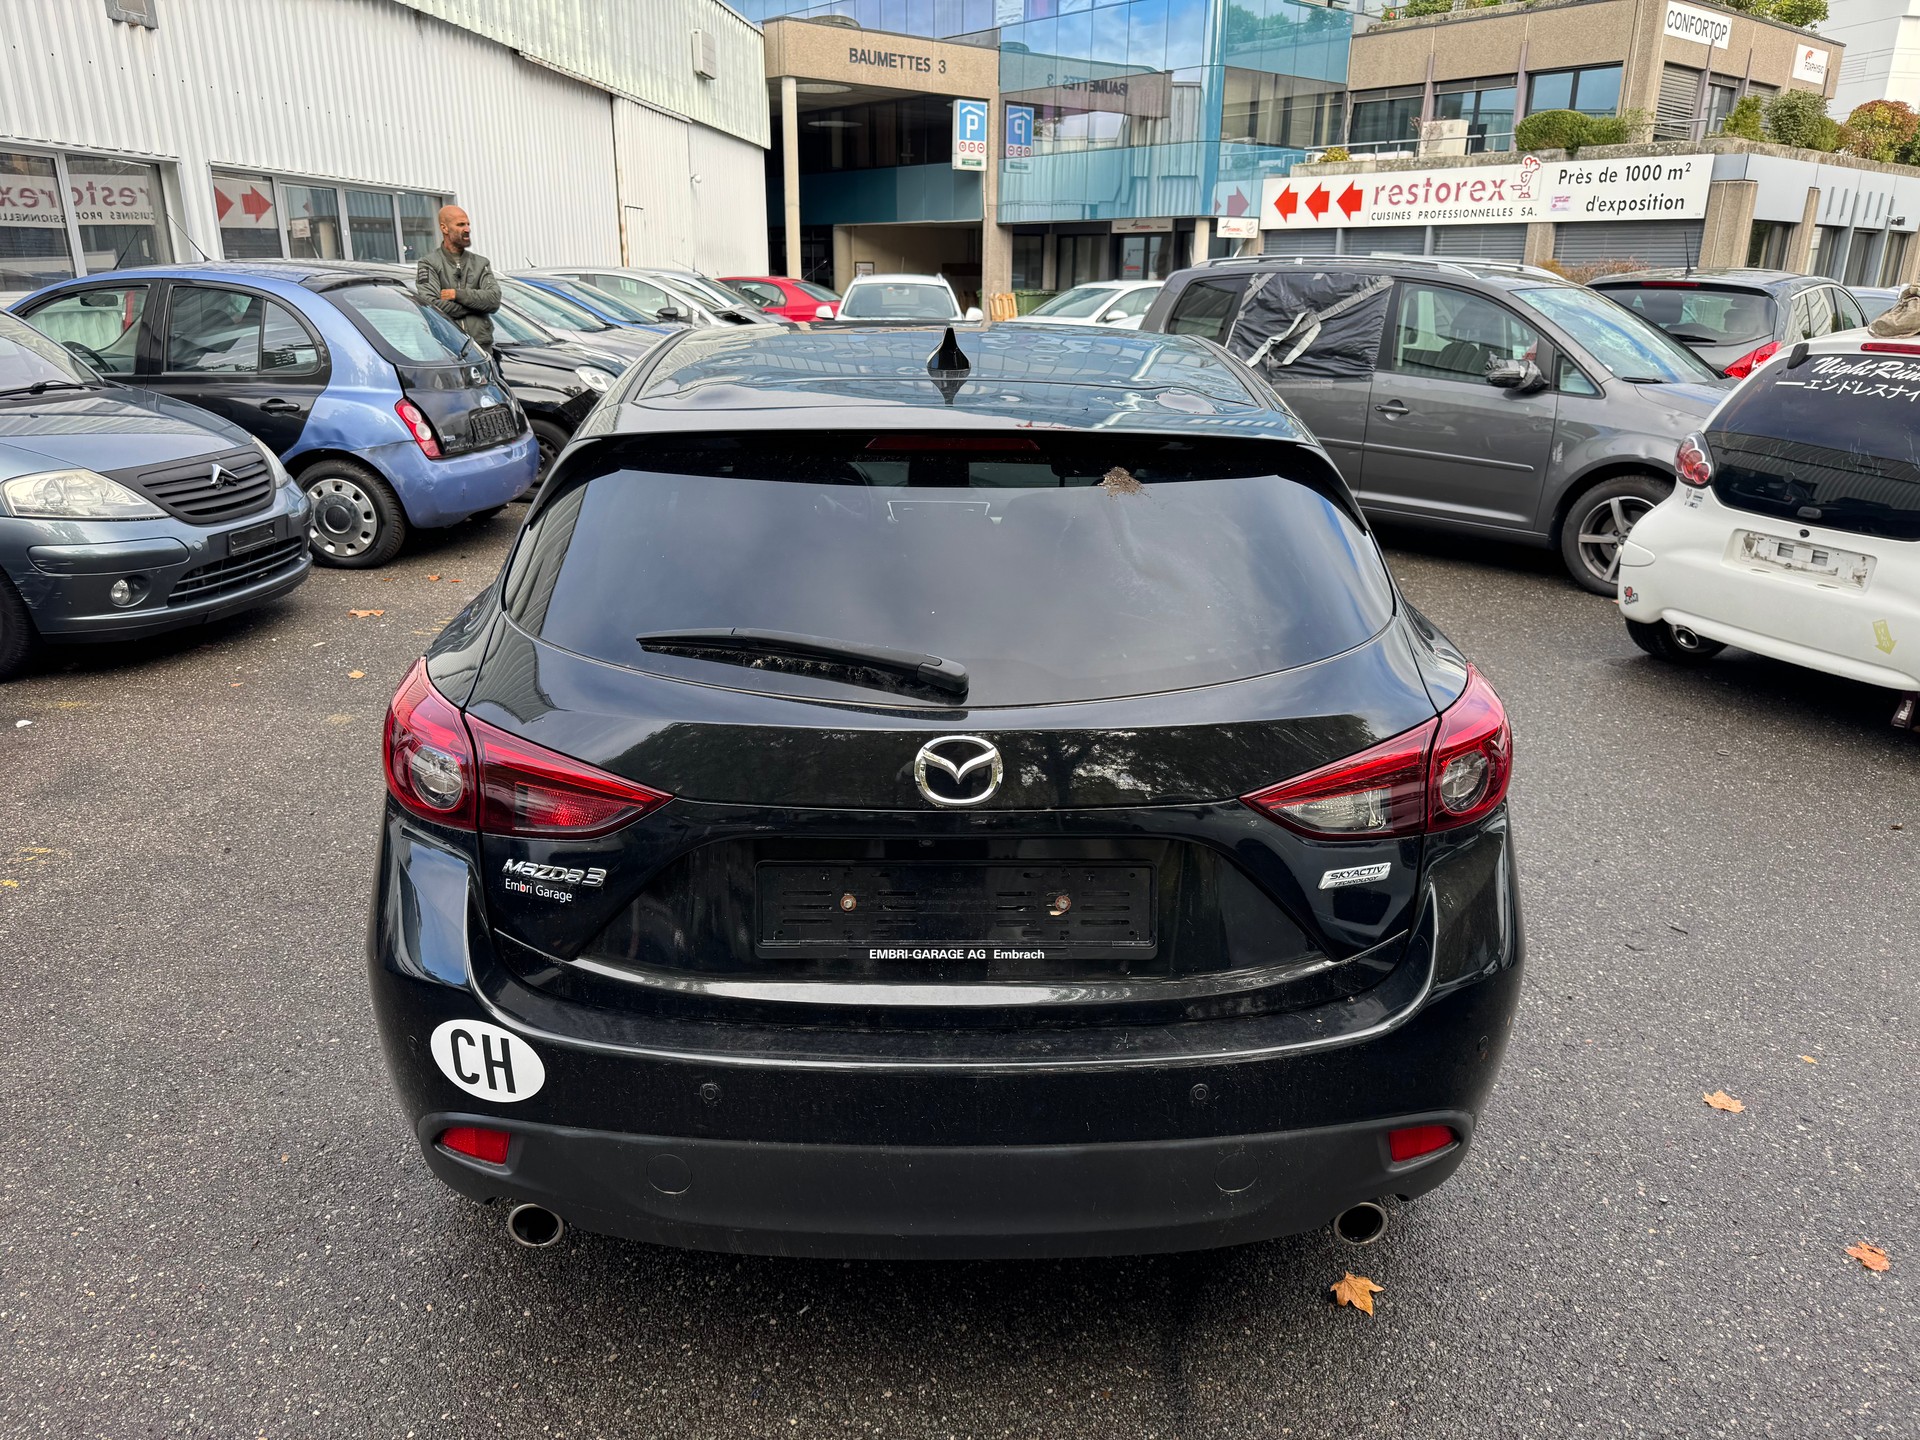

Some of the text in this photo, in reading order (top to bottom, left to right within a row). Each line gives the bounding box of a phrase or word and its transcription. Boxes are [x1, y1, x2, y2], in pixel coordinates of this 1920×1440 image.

[1667, 10, 1728, 42] CONFORTOP
[849, 48, 946, 74] BAUMETTES 3
[966, 114, 979, 139] P
[1558, 168, 1593, 185] Près
[1598, 167, 1618, 183] de
[1625, 164, 1662, 182] 1000
[1373, 177, 1508, 206] restorex
[1371, 207, 1538, 221] CUISINES PROFESSIONNELLES SA.
[1585, 193, 1685, 216] d'exposition
[1811, 356, 1878, 380] Night
[1330, 866, 1385, 880] SKYACTIV
[1334, 875, 1379, 887] TECHNOLOGY
[505, 878, 573, 903] Embri Garage
[869, 949, 1045, 960] EMBRI-GARAGE AG Embrach
[450, 1028, 516, 1094] CH
